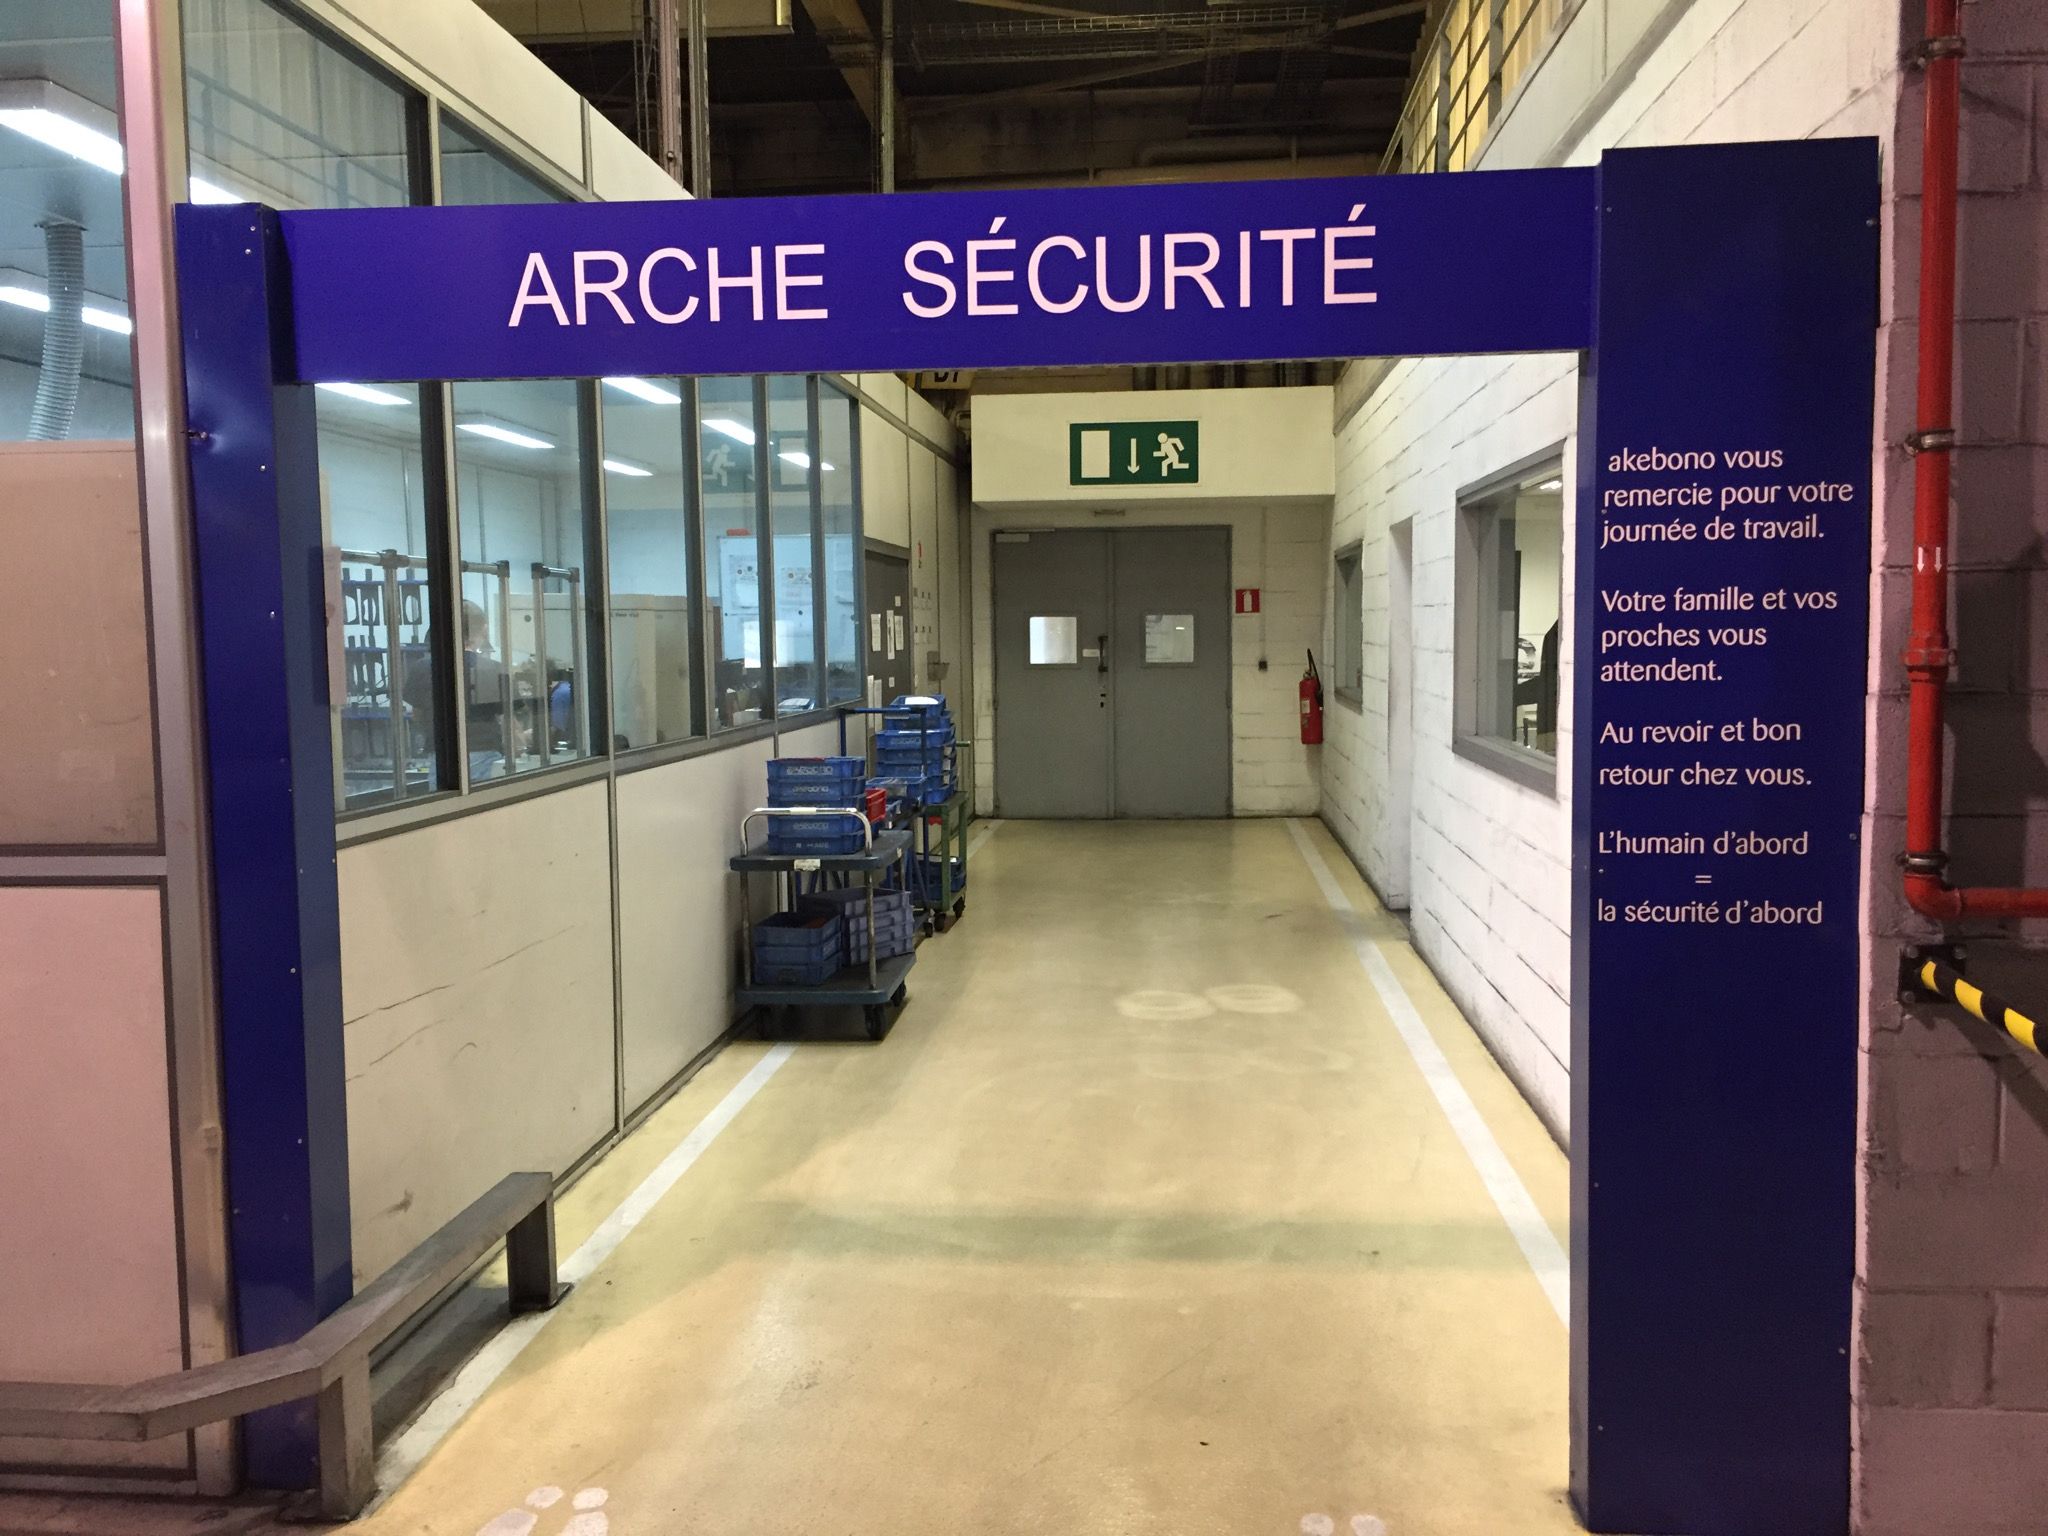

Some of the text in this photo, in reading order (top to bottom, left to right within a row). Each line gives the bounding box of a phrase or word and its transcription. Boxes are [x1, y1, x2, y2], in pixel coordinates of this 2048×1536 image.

[508, 203, 1378, 327] ARCHE SÉCURITÉ
[1607, 446, 1784, 473] akebono vous
[1604, 480, 1854, 512] remercie pour votre
[1599, 513, 1825, 550] journée de travail.
[1601, 585, 1838, 613] Votre famille et vos
[1601, 622, 1767, 654] proches vous
[1600, 657, 1723, 682] attendent.
[1599, 717, 1801, 744] Au revoir et bon
[1599, 761, 1812, 786] retour chez vous.
[1598, 829, 1809, 855] L'humain d'abord
[1598, 897, 1823, 925] la sécurité d'abord
